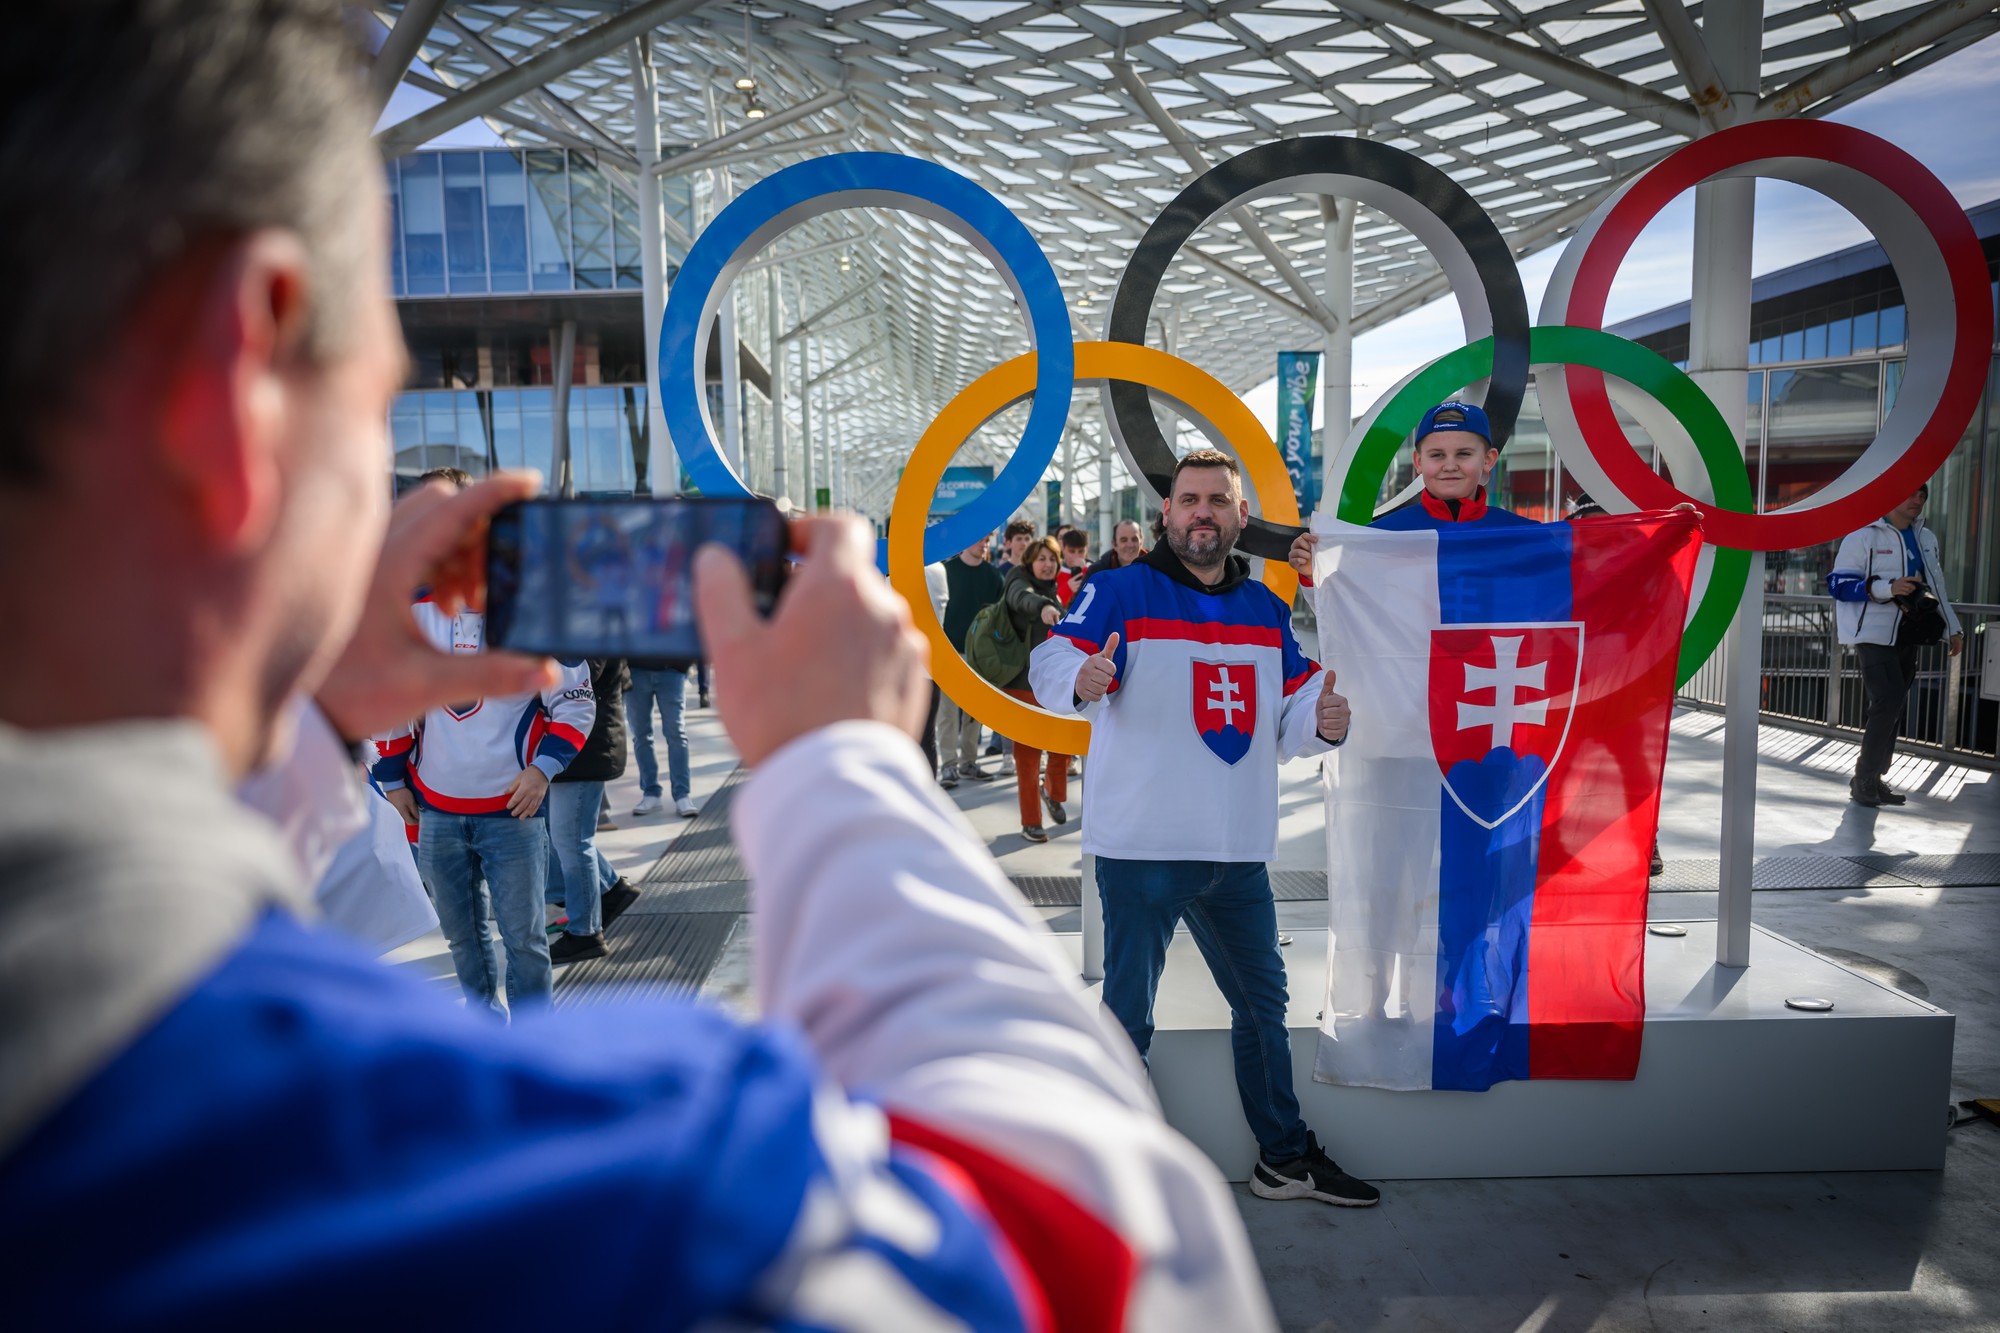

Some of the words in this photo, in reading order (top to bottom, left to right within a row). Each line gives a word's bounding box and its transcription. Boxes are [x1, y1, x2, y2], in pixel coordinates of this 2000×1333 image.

[1286, 360, 1311, 405] vibe
[1286, 407, 1305, 467] your
[1057, 582, 1097, 625] 1
